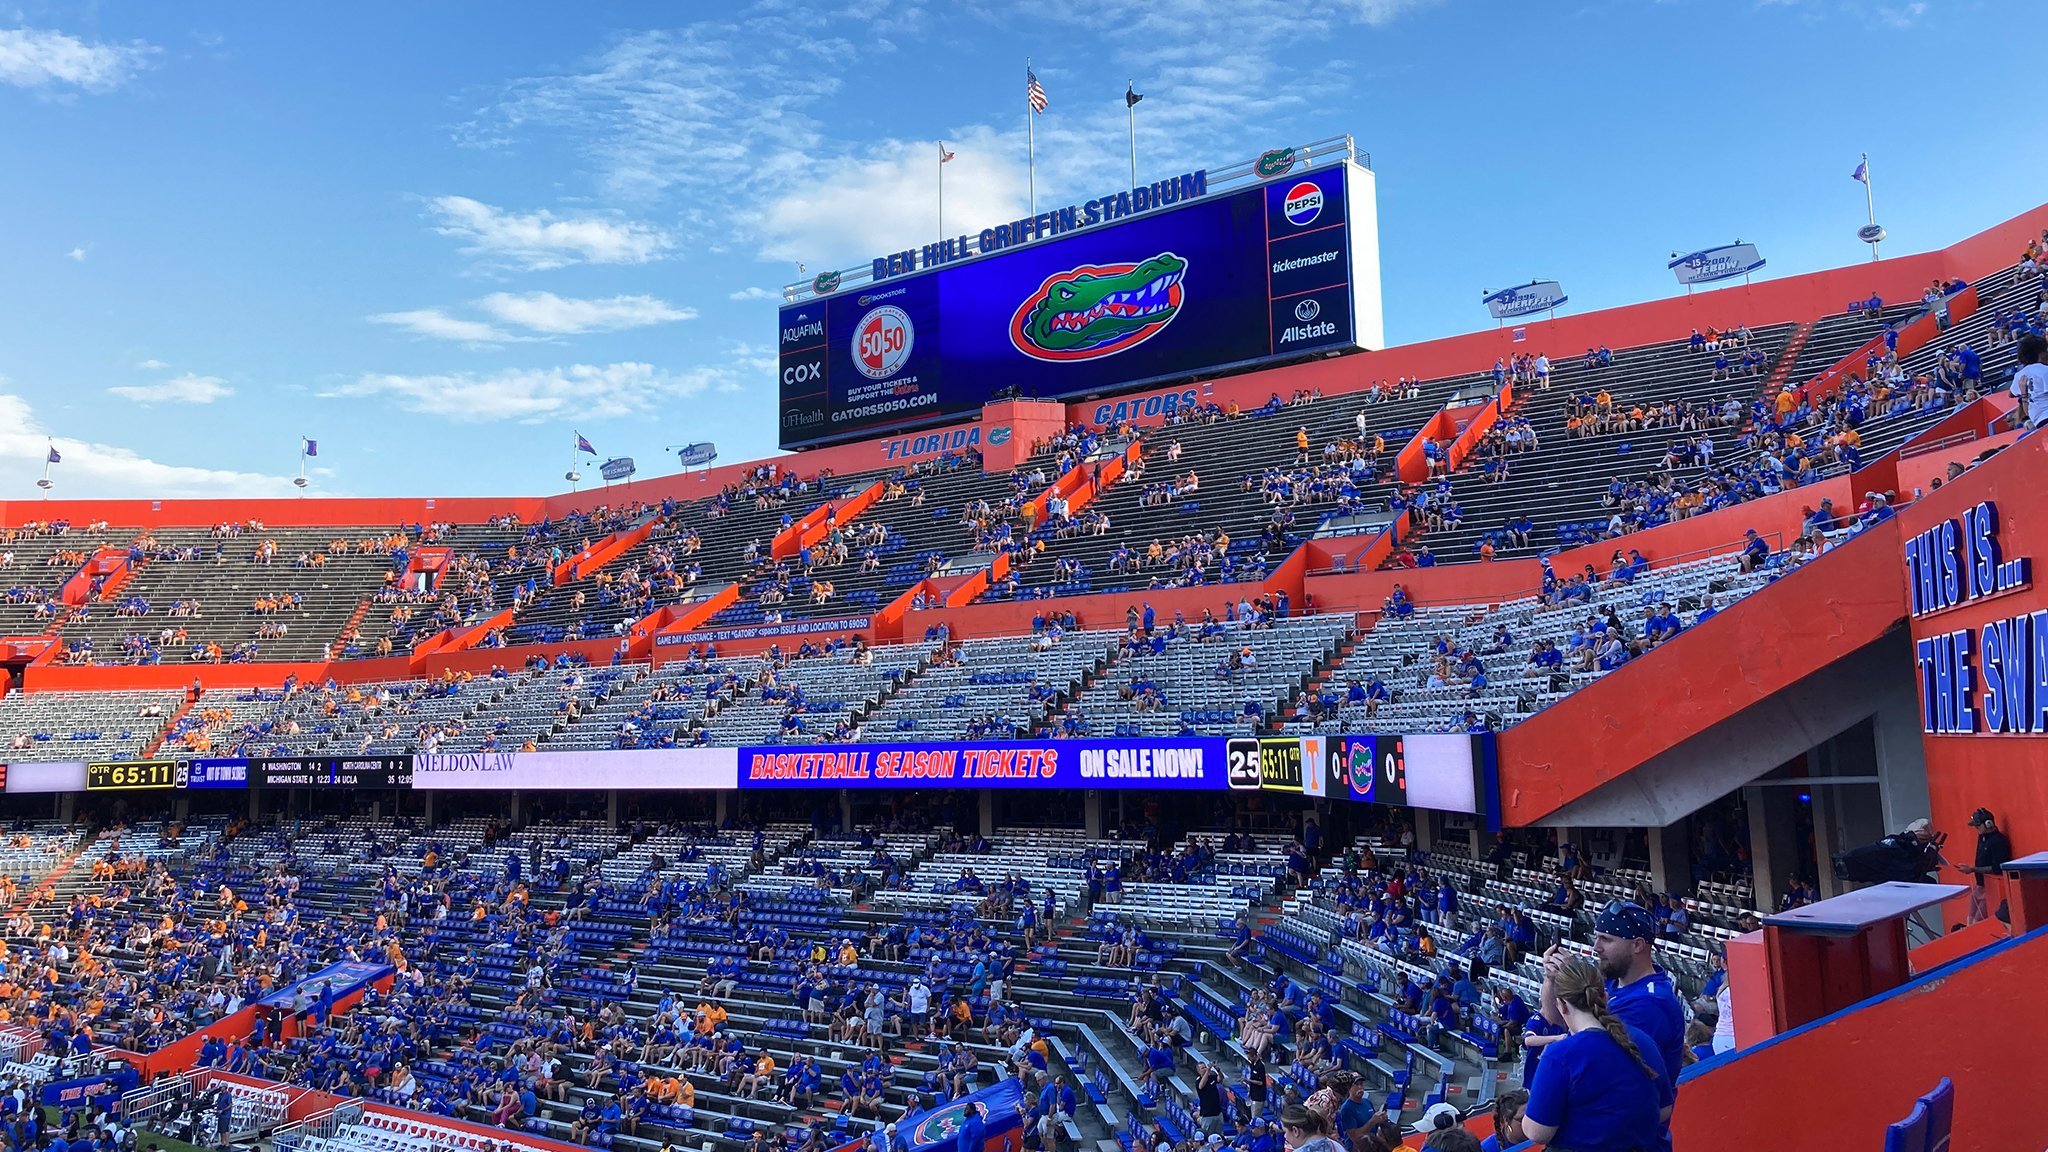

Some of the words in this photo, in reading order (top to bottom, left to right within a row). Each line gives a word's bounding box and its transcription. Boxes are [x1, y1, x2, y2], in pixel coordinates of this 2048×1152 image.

[1286, 196, 1321, 212] PEPSI
[873, 249, 916, 281] BEN
[922, 234, 973, 268] HILL
[979, 205, 1077, 253] GRIFFIN
[1083, 169, 1207, 224] STADIUM
[1272, 250, 1338, 273] ticketmaster
[1692, 258, 1701, 267] 15
[1696, 260, 1739, 275] TEBOW
[1705, 256, 1731, 265] 2007
[873, 288, 907, 301] BOOKSTORE
[781, 320, 824, 345] AQUAFINA
[1280, 321, 1336, 344] Allstate
[784, 361, 821, 385] COX
[866, 363, 899, 377] RAFFLE
[848, 387, 861, 396] BUY
[863, 383, 882, 393] YOUR
[882, 377, 912, 388] TICKETS
[848, 391, 879, 403] SUPPORT
[880, 388, 894, 397] THE
[831, 393, 937, 422] GATORS5050.COM
[1093, 388, 1198, 426] GATORS
[887, 427, 981, 460] FLORIDA
[1905, 518, 1959, 618] THIS
[657, 636, 672, 645] GAME
[672, 635, 683, 644] DAY
[682, 632, 714, 643] ASSISTANCE
[717, 630, 730, 639] TEXT
[758, 627, 780, 637] <space>
[780, 624, 796, 635] ISSUE
[796, 623, 809, 633] AND
[810, 621, 839, 632] LOCATION
[839, 620, 848, 629] TO
[848, 618, 868, 629] 69050
[1917, 629, 1974, 734] THE
[1289, 747, 1300, 761] QTR
[90, 766, 110, 774] QTR
[268, 762, 302, 771] WASHINGTON
[308, 762, 315, 771] 14
[749, 752, 870, 780] BASKETBALL
[874, 751, 955, 779] SEASON
[962, 749, 1058, 778] TICKETS
[1080, 749, 1105, 778] ON
[1106, 748, 1152, 778] SALE
[1153, 748, 1204, 778] NOW!
[1230, 750, 1259, 778] 25
[1262, 748, 1289, 780] 65:11
[1332, 751, 1341, 780] 0
[1385, 752, 1395, 784] 0
[98, 775, 103, 784] 1
[112, 765, 169, 784] 65:11
[176, 767, 188, 782] 25
[267, 775, 292, 784] MICHIGAN
[292, 775, 308, 784] STATE
[317, 775, 331, 784] 12:23
[334, 775, 341, 784] 24
[341, 775, 358, 784] UCLA
[387, 775, 395, 784] 35
[397, 775, 413, 784] 12:05
[1294, 766, 1299, 782] 1
[1646, 981, 1655, 993] 1
